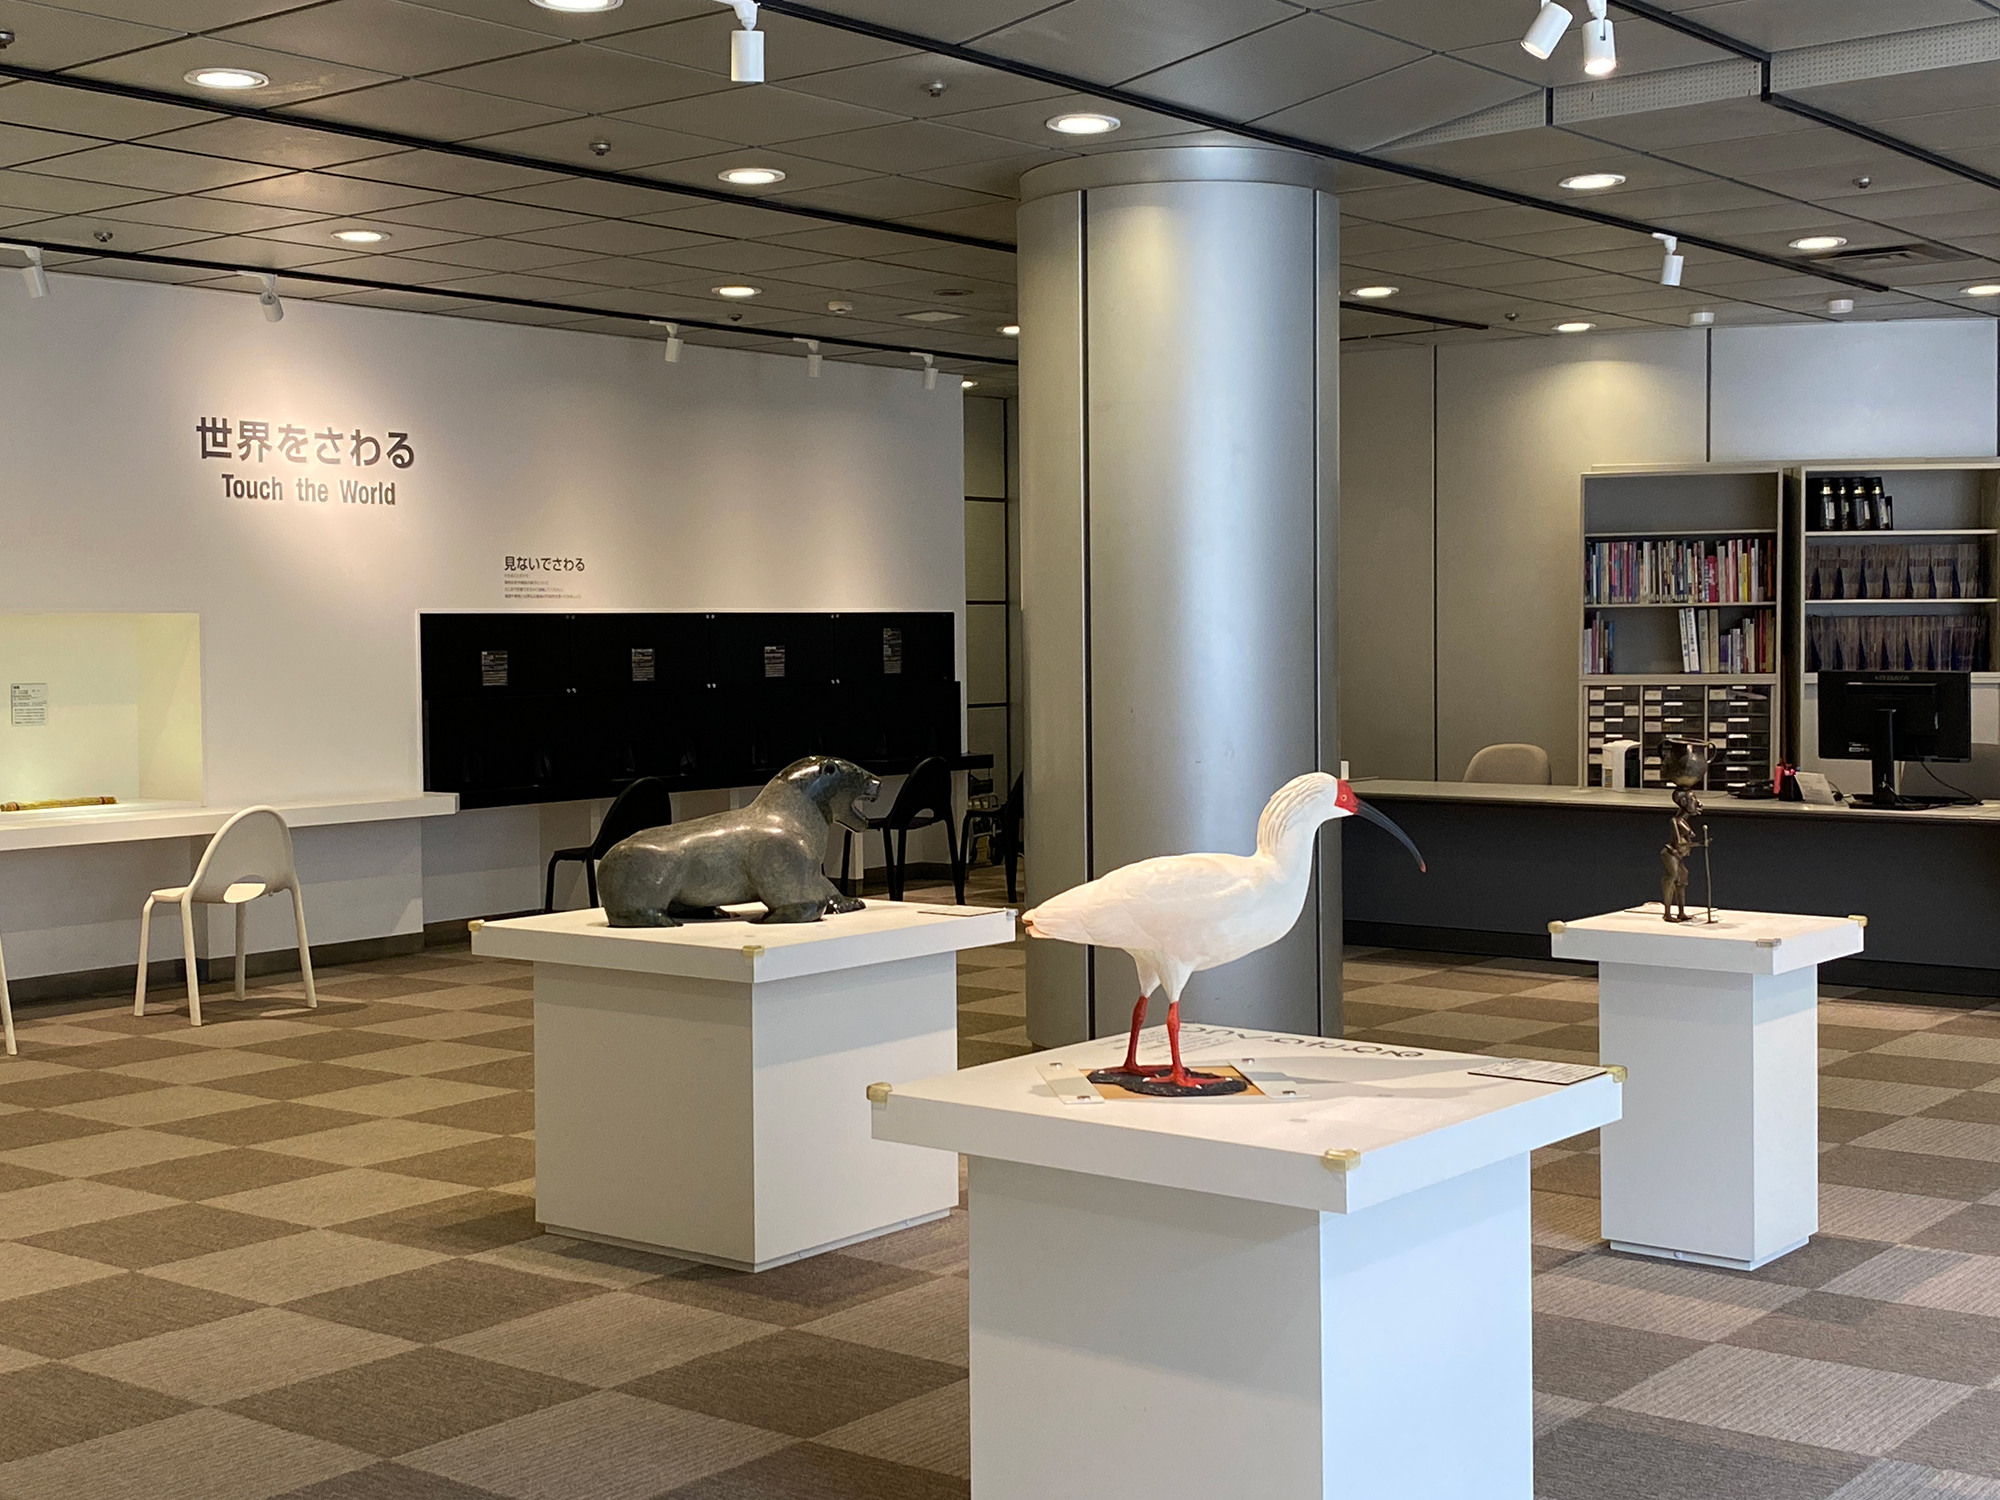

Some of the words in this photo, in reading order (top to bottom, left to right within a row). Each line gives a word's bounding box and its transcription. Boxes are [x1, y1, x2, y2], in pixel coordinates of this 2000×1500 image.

[196, 417, 415, 469] 世界をさわる
[222, 474, 283, 500] Touch
[296, 477, 329, 502] the
[340, 479, 396, 505] World
[504, 556, 585, 572] 見ないでさわる
